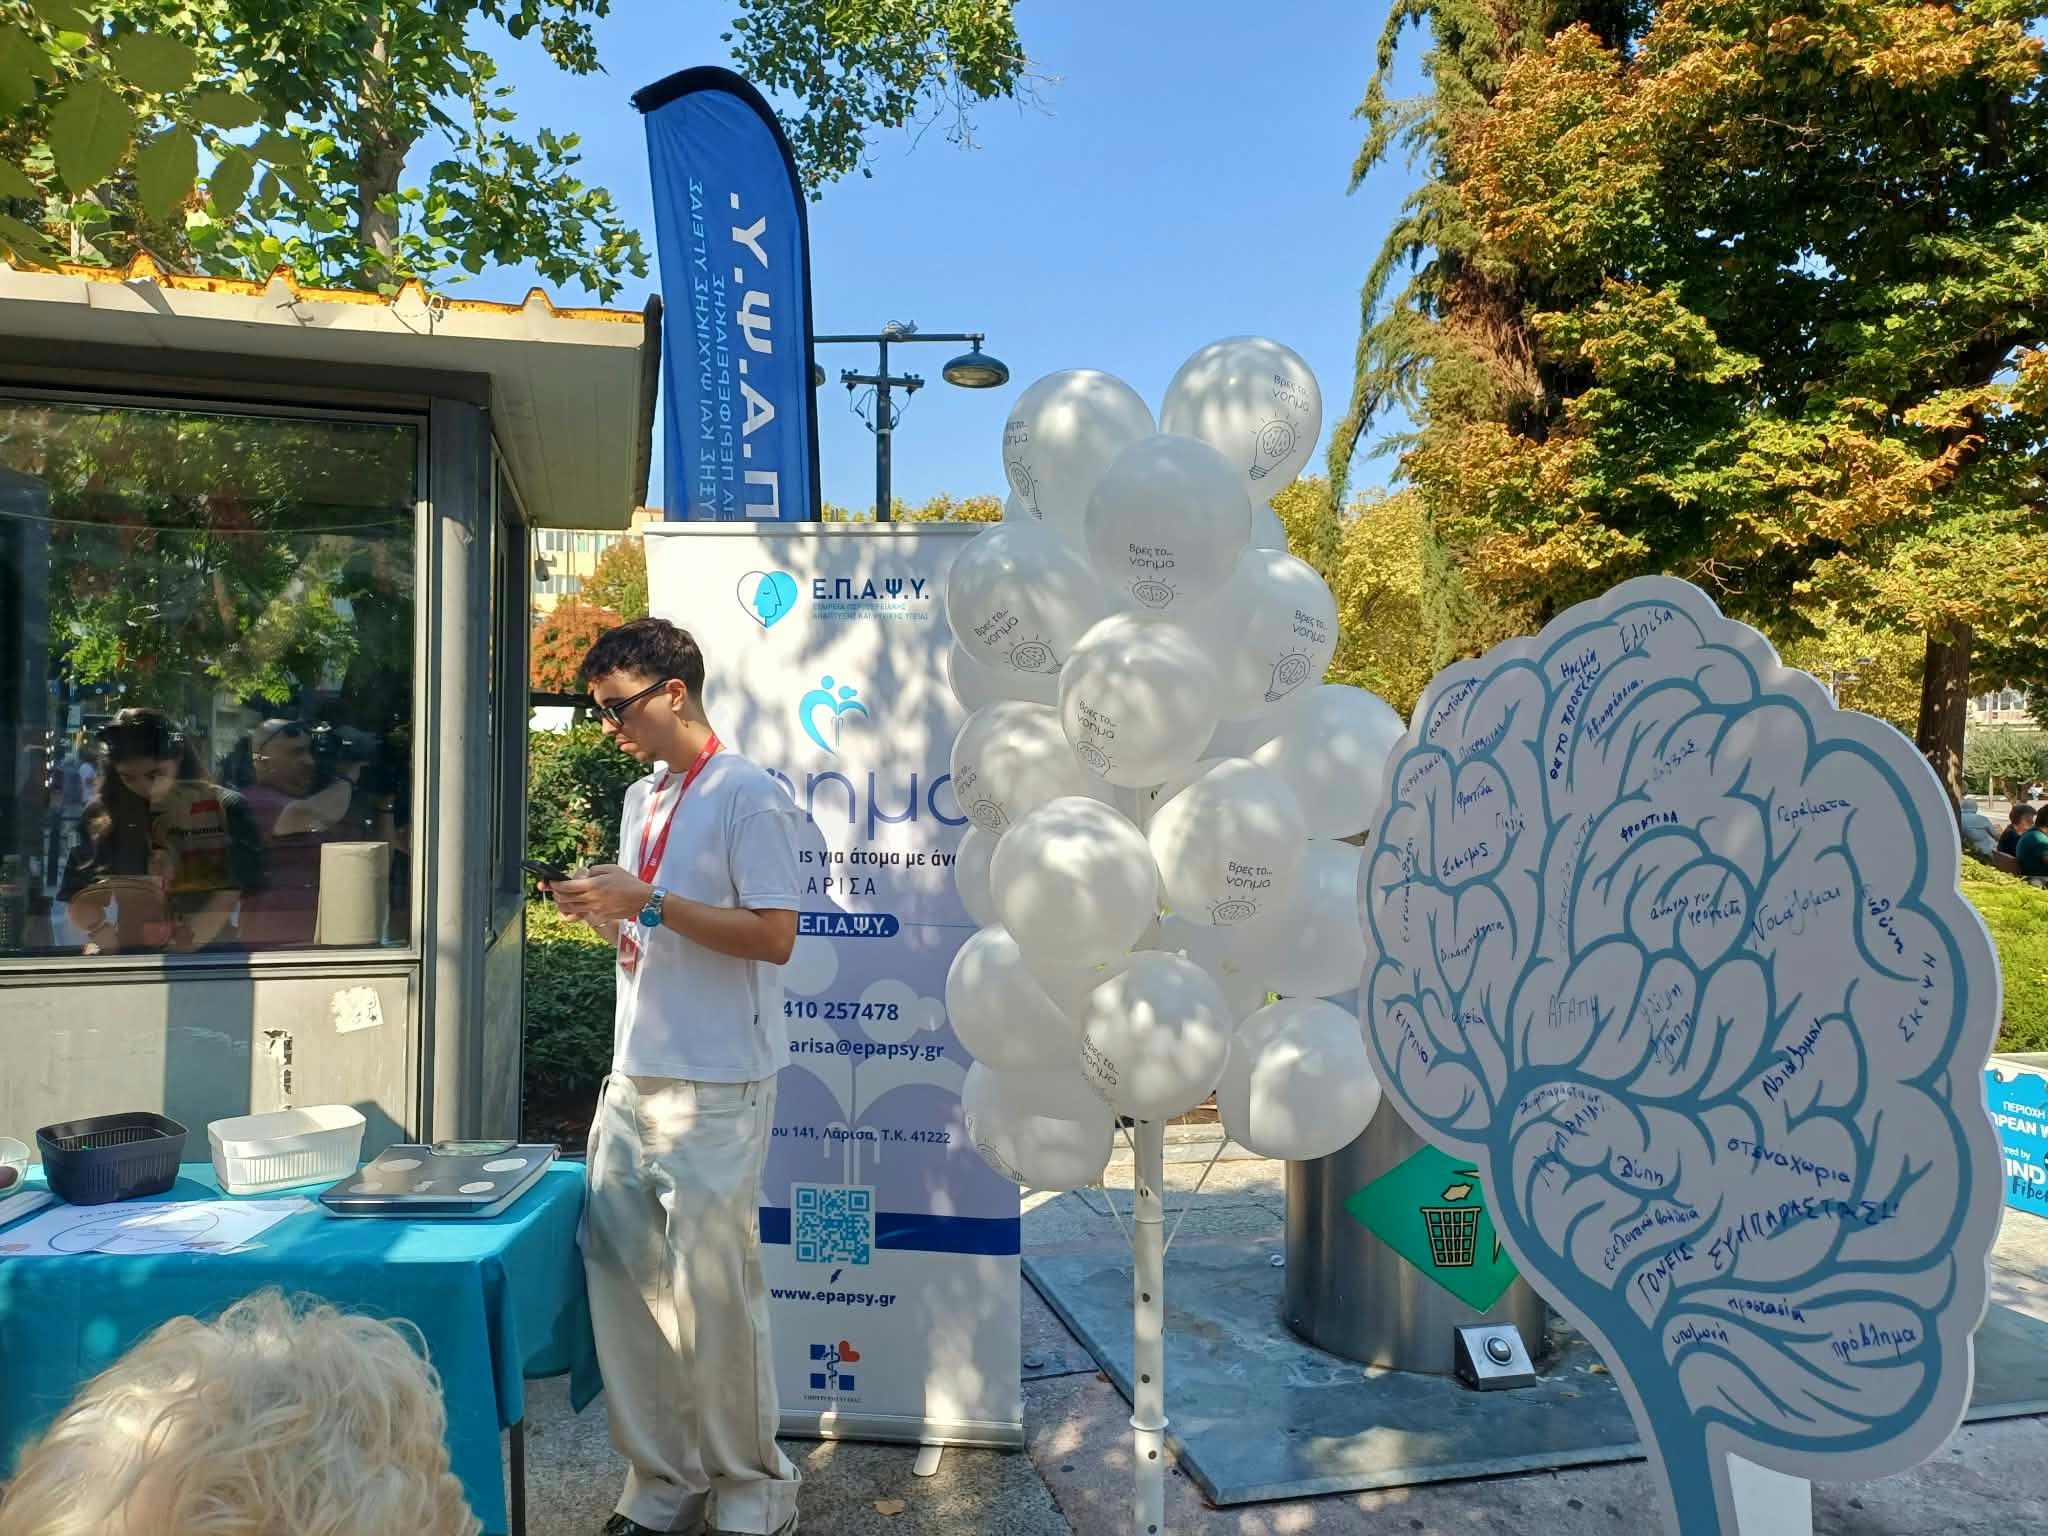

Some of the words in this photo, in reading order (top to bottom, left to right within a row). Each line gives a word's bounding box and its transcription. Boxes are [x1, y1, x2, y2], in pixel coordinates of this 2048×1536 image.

[812, 578, 929, 600] Ε.Π.Α.Ψ.Υ.
[818, 851, 844, 866] για
[850, 847, 899, 868] άτομα
[906, 852, 925, 868] με
[801, 877, 876, 896] ΑΡΙΣΑ
[799, 915, 889, 935] Ε.Π.Α.Ψ.Υ.
[784, 1001, 818, 1018] 410
[824, 1002, 899, 1021] 257478
[789, 1038, 945, 1061] arisa@epapsy.gr
[2006, 1159, 2046, 1185] IND
[770, 1287, 896, 1307] www.epapsy.gr
